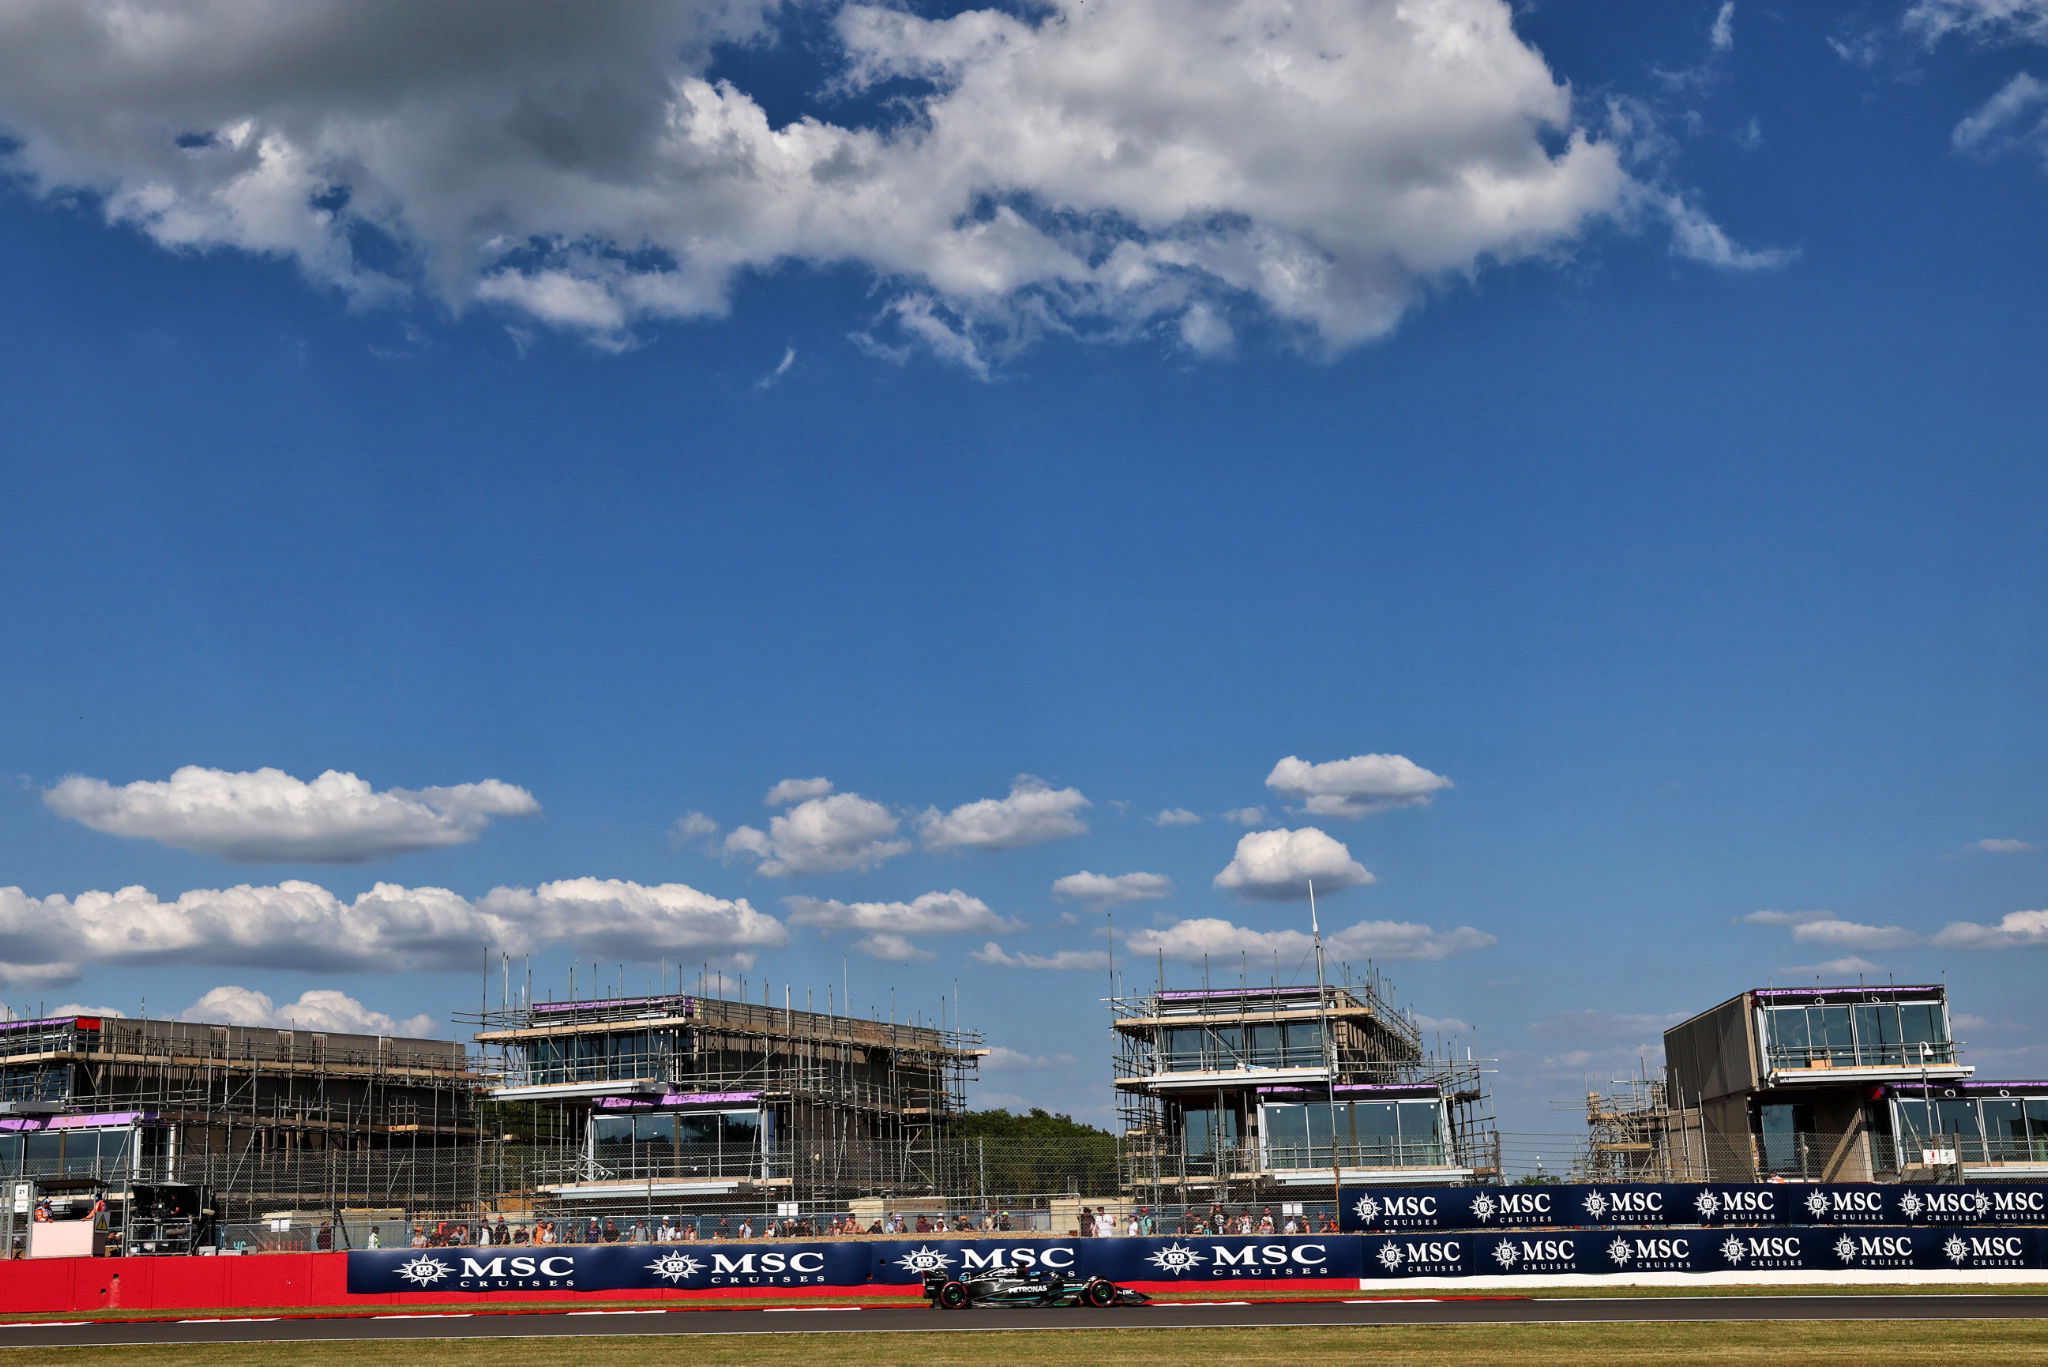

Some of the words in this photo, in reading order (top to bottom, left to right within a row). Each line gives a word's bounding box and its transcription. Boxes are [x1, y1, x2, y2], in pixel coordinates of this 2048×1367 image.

[1383, 1197, 1436, 1215] MSC
[1499, 1194, 1550, 1213] MSC
[1610, 1193, 1662, 1211] MSC
[1722, 1192, 1773, 1210] MSC
[1832, 1192, 1881, 1210] MSC
[1925, 1194, 1975, 1211] MSC
[1992, 1192, 2043, 1210] MSC
[1499, 1215, 1552, 1224] CRUISES
[1212, 1245, 1326, 1265] MSC
[1406, 1242, 1460, 1262] MSC
[1520, 1240, 1574, 1260] MSC
[1636, 1239, 1689, 1258] MSC
[1747, 1238, 1800, 1256] MSC
[1860, 1237, 1912, 1256] MSC
[1969, 1237, 2022, 1256] MSC
[461, 1257, 573, 1277] MSC
[712, 1253, 823, 1273] MSC
[961, 1248, 1074, 1269] MSC
[1522, 1262, 1576, 1271] CRUISES
[1636, 1261, 1691, 1269] CRUISES
[1750, 1259, 1802, 1267] CRUISES
[1212, 1267, 1328, 1276] CRUISES
[1407, 1264, 1462, 1273] CRUISES
[459, 1279, 574, 1288] CRUISES
[710, 1275, 825, 1284] CRUISES
[1008, 1284, 1048, 1294] PETRONAS
